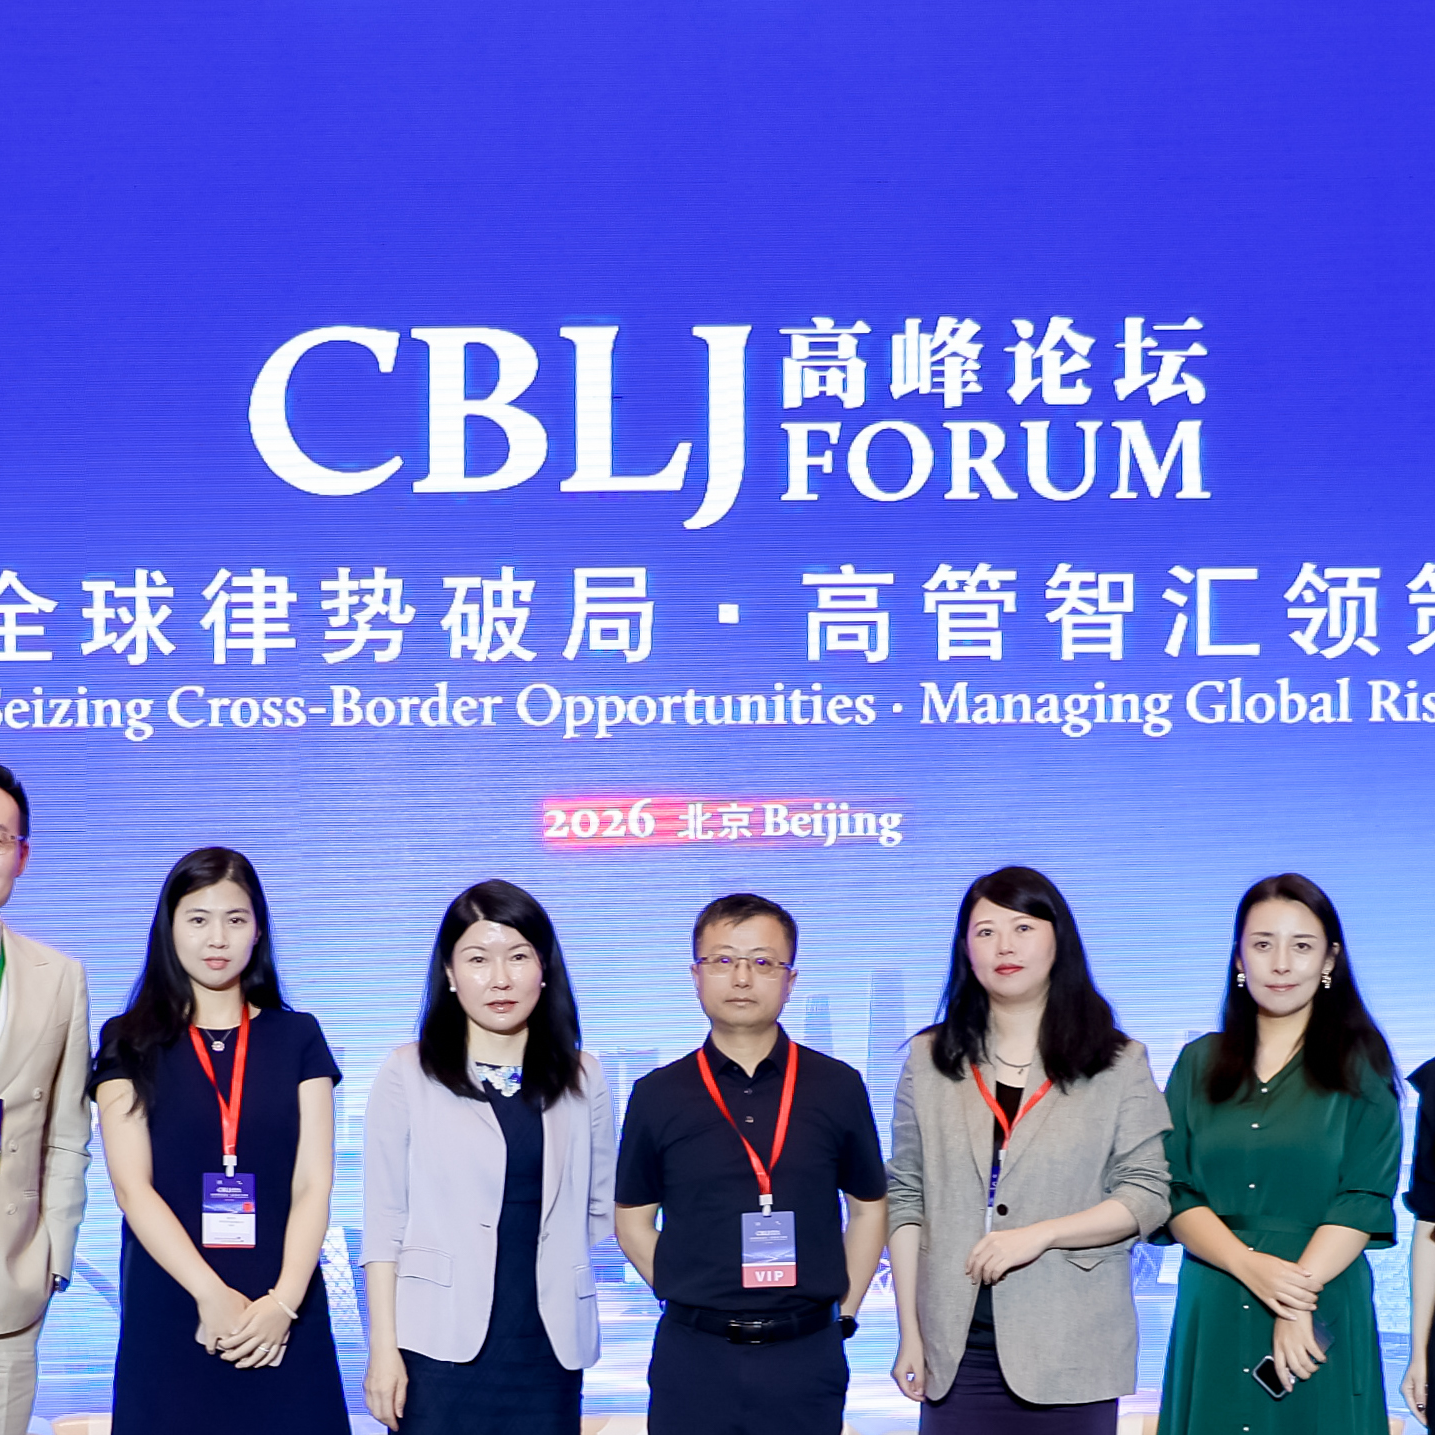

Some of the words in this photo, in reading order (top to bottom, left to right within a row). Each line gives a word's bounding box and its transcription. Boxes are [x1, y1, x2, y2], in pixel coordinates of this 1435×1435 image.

[779, 316, 1208, 410] 高峰论坛
[249, 325, 752, 530] CBLJ
[780, 420, 1211, 502] FORUM
[167, 682, 503, 730] Cross-Border
[516, 682, 876, 739] Opportunities
[920, 682, 1173, 737] Managing
[1186, 677, 1352, 725] Global
[544, 798, 655, 838] 2026
[677, 802, 753, 840] 北京
[761, 802, 903, 847] Beijing
[755, 1270, 784, 1282] VIP
